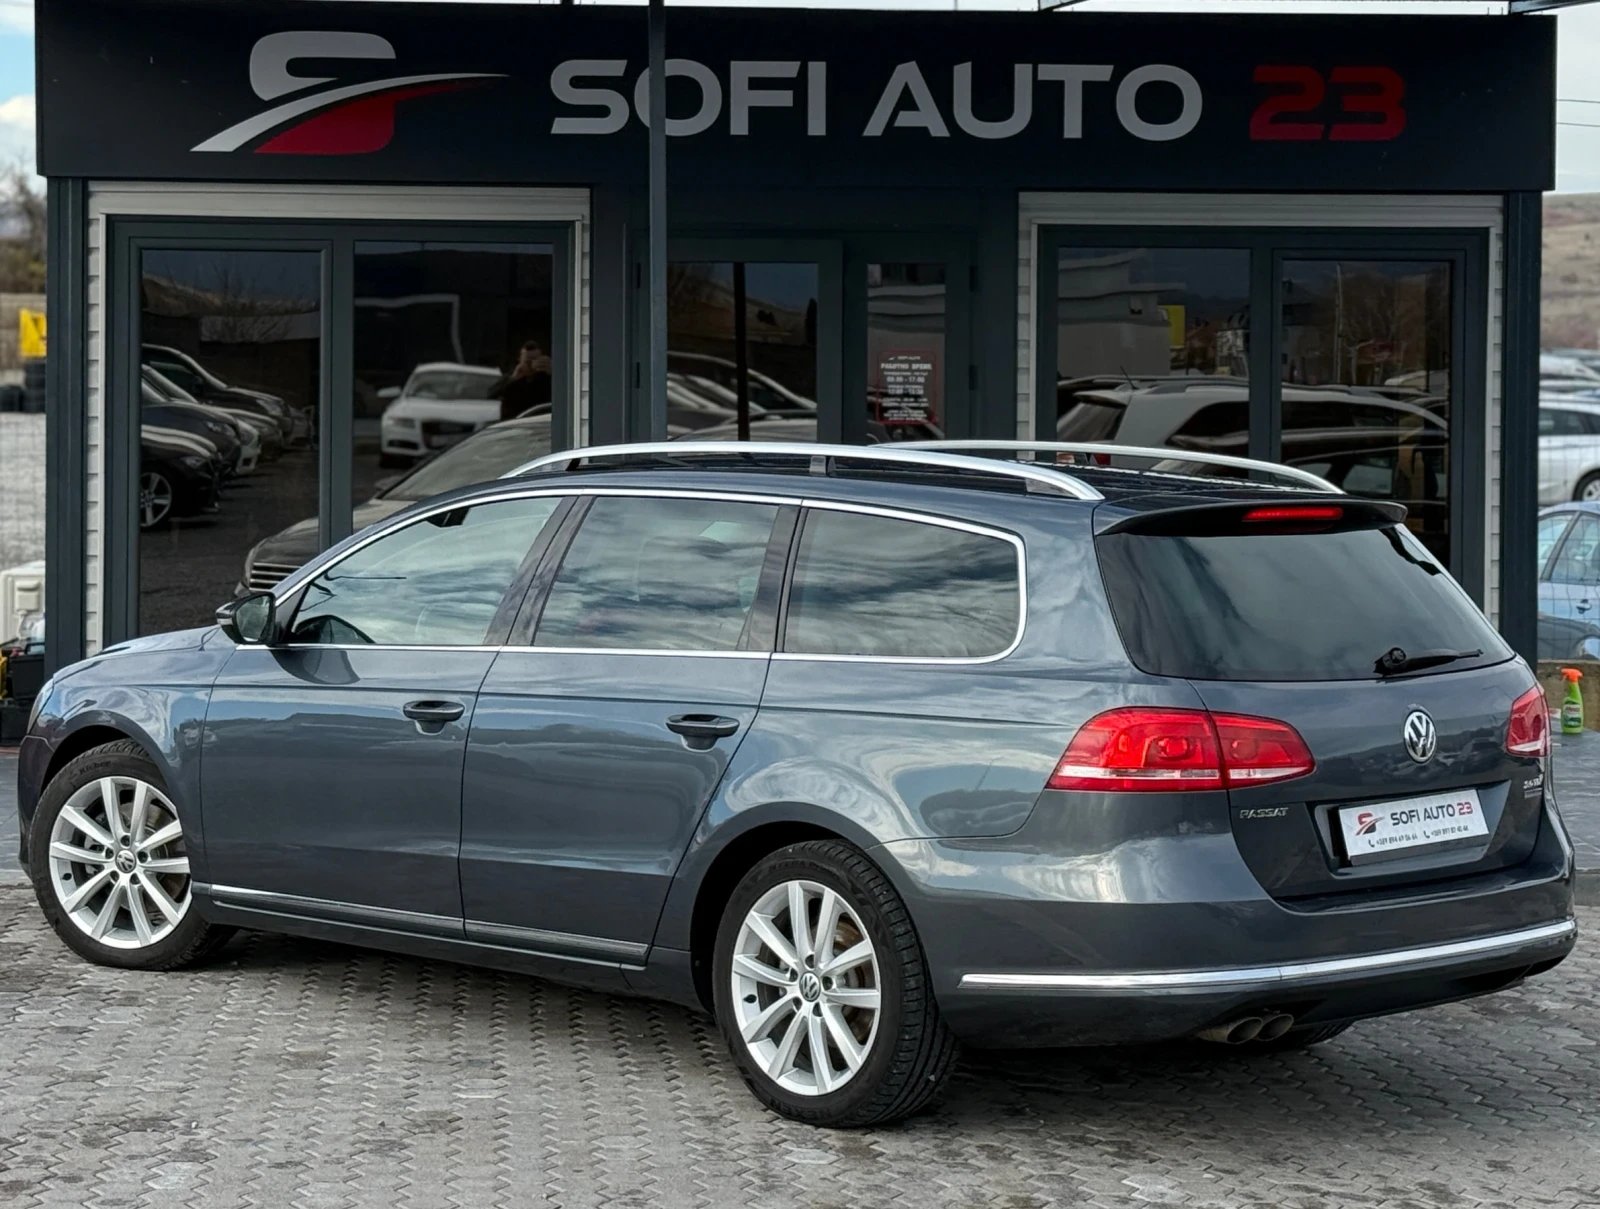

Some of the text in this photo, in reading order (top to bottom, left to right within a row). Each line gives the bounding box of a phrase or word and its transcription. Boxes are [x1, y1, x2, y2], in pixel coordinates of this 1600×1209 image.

[550, 59, 1407, 142] SOFI AUTO 23
[1239, 807, 1289, 819] PASSAT
[1390, 801, 1474, 826] SOFI AUTO 23
